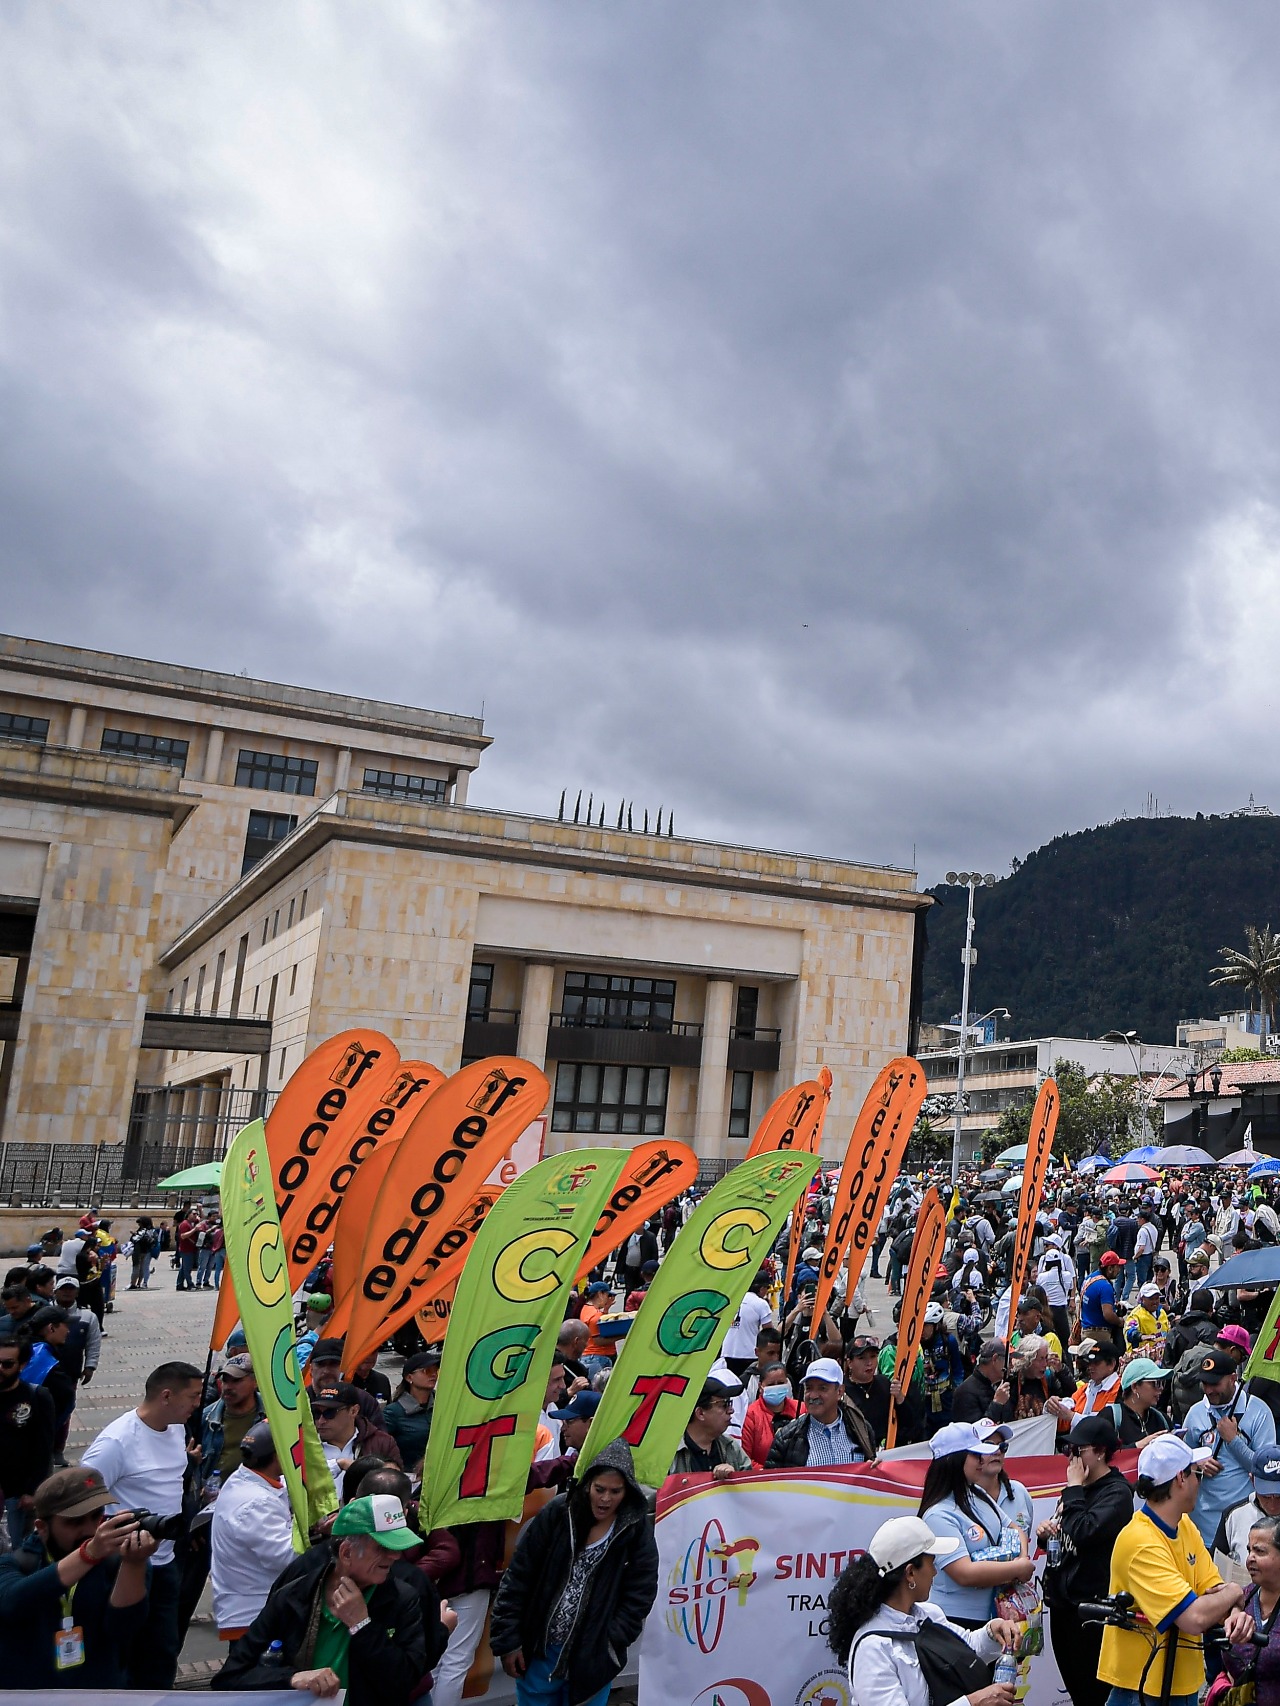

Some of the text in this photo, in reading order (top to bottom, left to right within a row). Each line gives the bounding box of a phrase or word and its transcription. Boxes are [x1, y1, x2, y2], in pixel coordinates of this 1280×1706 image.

[291, 1079, 430, 1264] fecode
[363, 1077, 527, 1301] fecode
[1015, 1094, 1055, 1285] fecode
[454, 1227, 579, 1500] CGT
[619, 1206, 772, 1448] CGT
